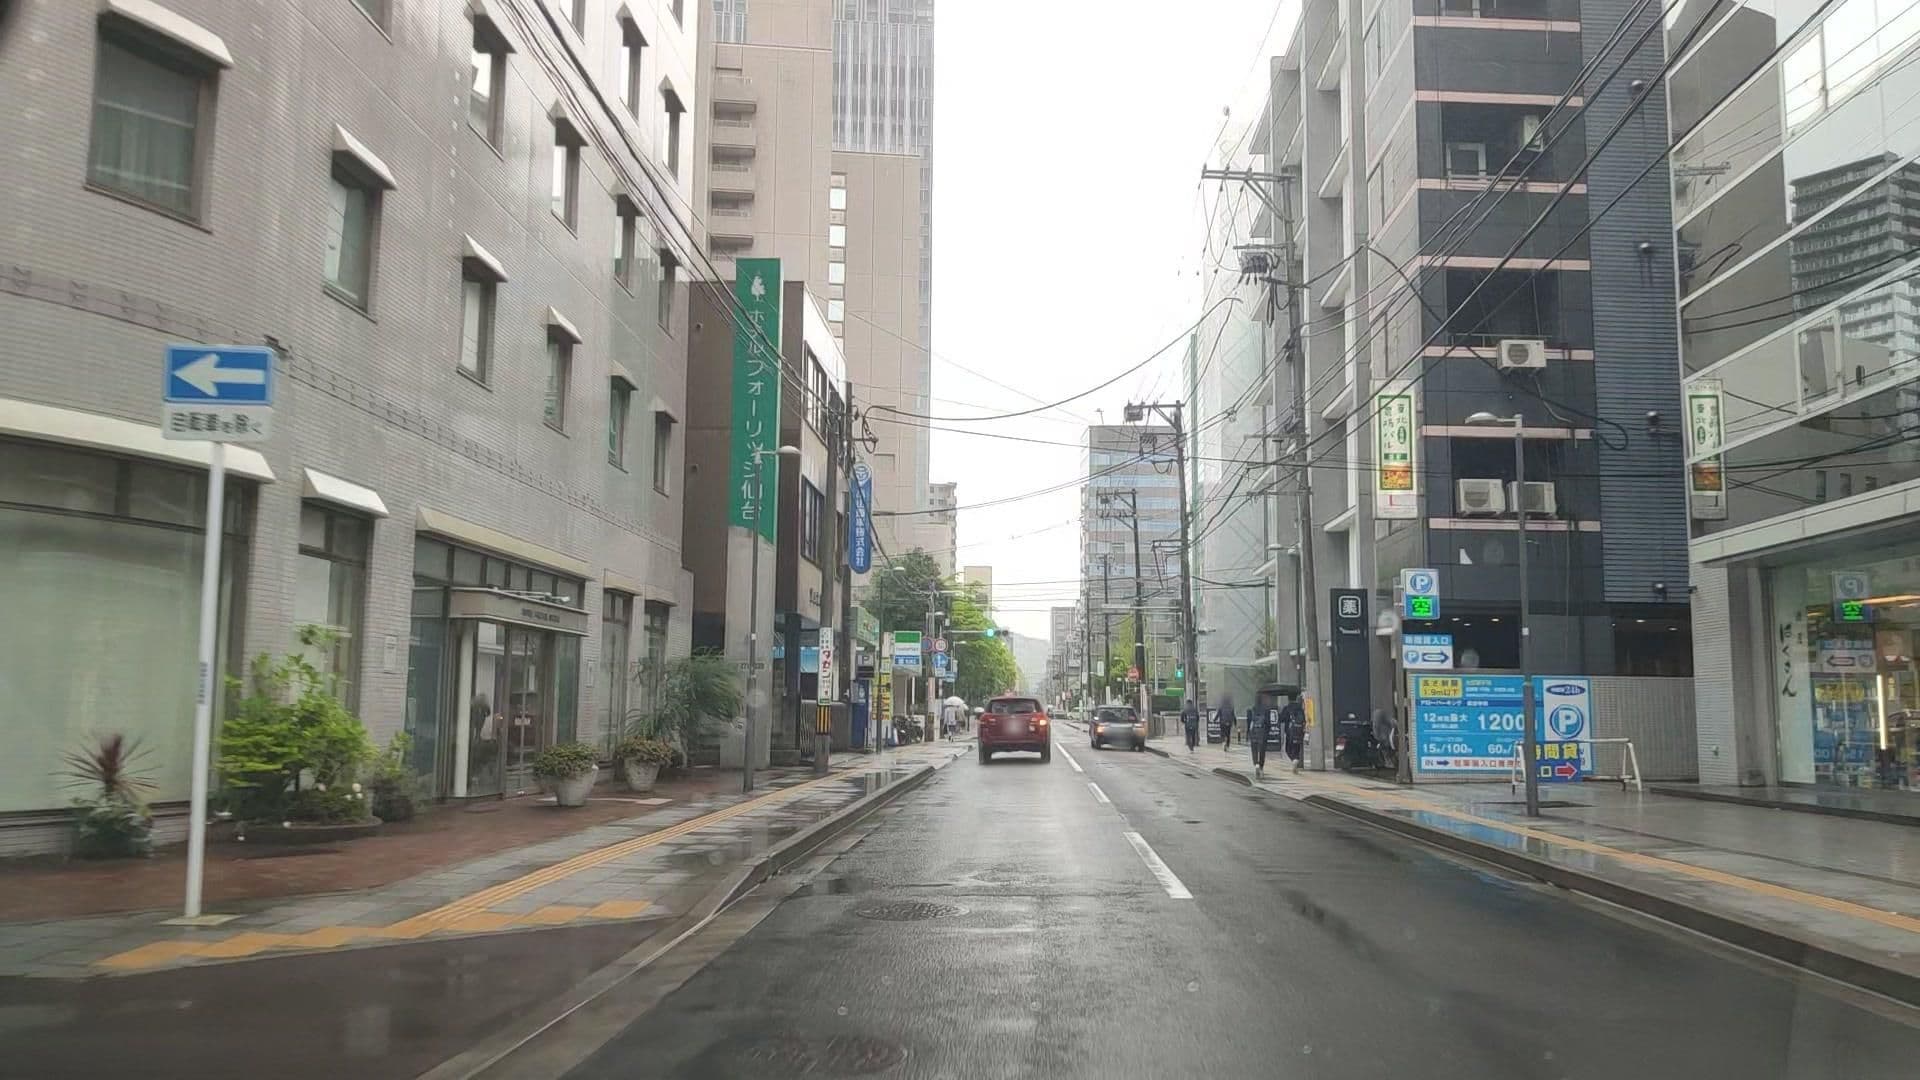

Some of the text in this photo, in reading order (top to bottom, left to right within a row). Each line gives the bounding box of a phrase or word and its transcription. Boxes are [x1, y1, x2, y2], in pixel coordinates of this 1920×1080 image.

[171, 412, 263, 435] 自転車を除く
[1415, 576, 1429, 590] P
[1343, 599, 1357, 614] 薬
[1412, 596, 1432, 616] 空
[1478, 713, 1537, 731] 1200
[1558, 709, 1578, 733] P
